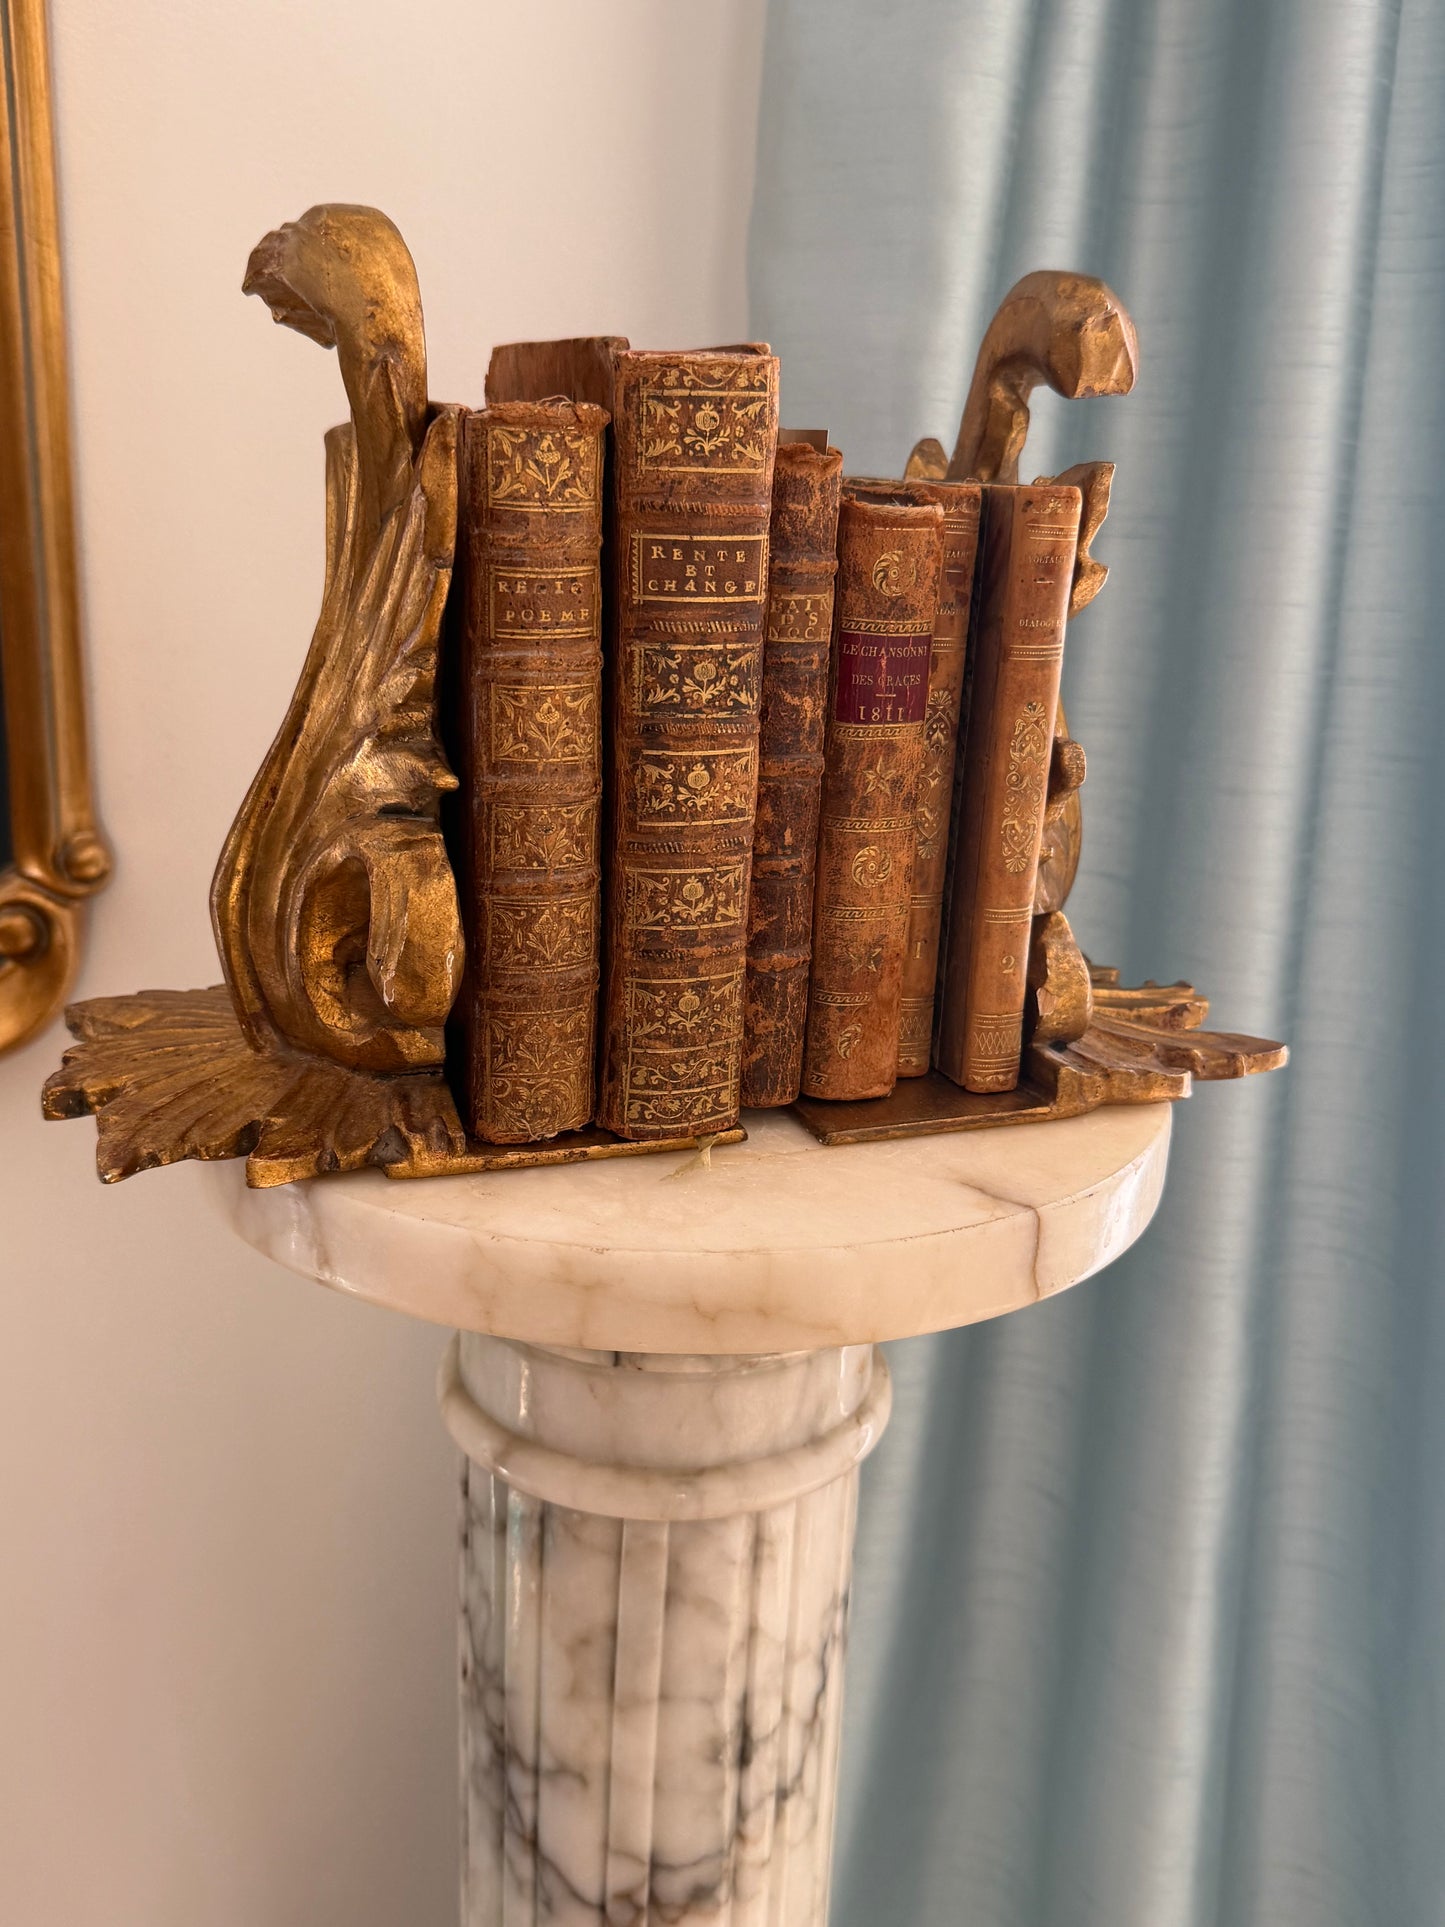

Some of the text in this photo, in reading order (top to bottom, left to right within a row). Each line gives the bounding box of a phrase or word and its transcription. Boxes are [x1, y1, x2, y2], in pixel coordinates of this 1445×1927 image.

[651, 545, 747, 563] RENTE
[648, 579, 757, 594] CHANGE
[851, 673, 874, 687] DES
[1001, 955, 1016, 975] 2
